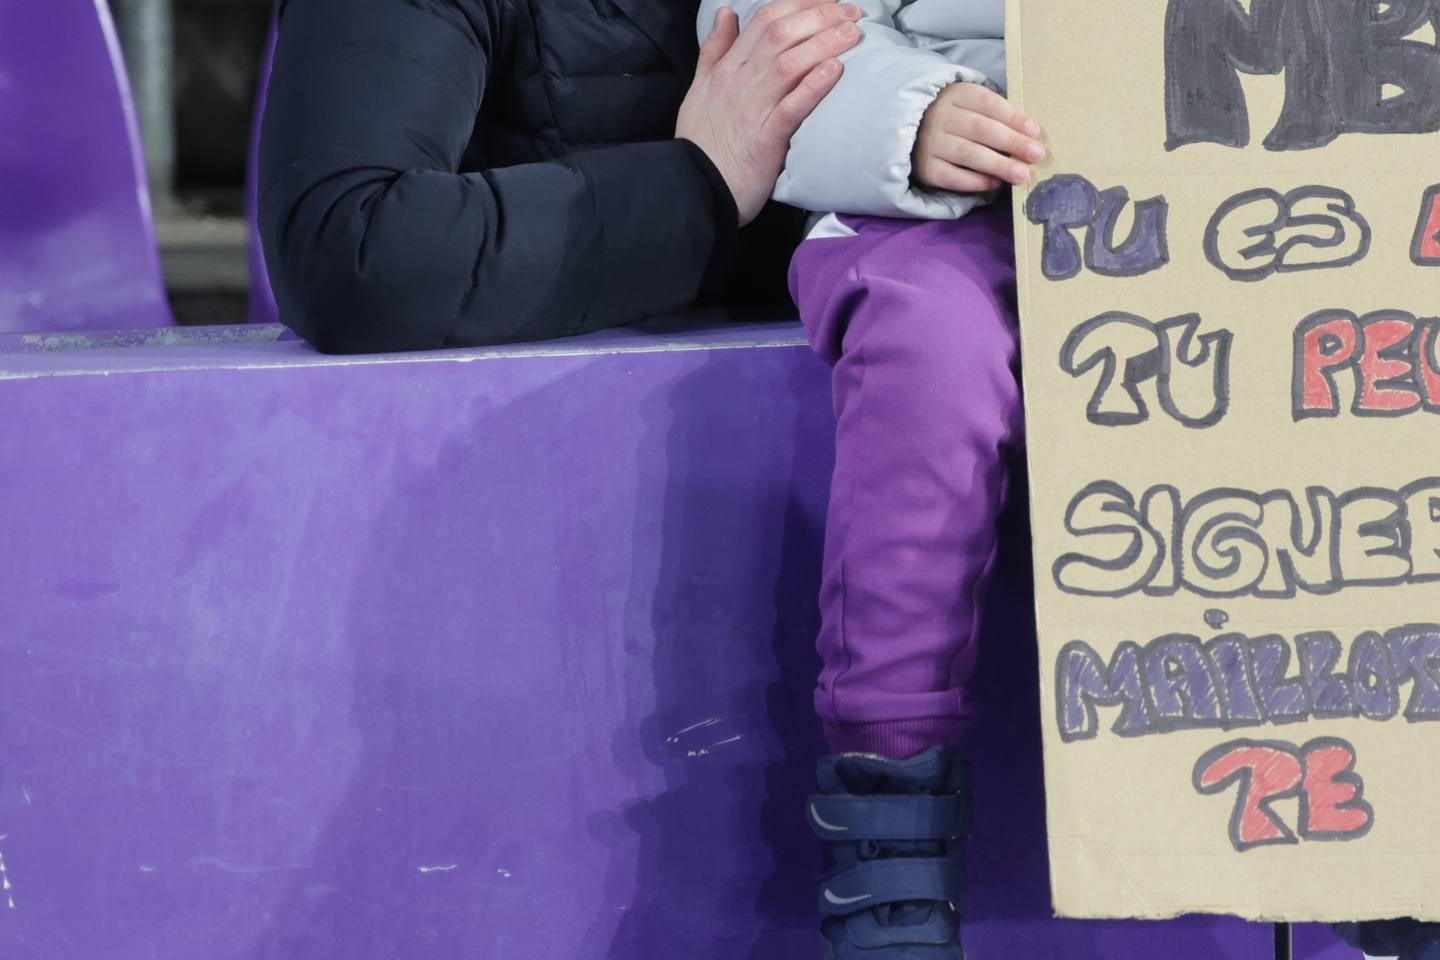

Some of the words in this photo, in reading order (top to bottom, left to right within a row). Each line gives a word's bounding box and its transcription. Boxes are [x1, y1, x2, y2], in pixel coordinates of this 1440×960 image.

[1025, 173, 1169, 281] TU
[1202, 184, 1372, 282] ES
[1059, 310, 1234, 429] TU
[1192, 735, 1374, 852] TE
